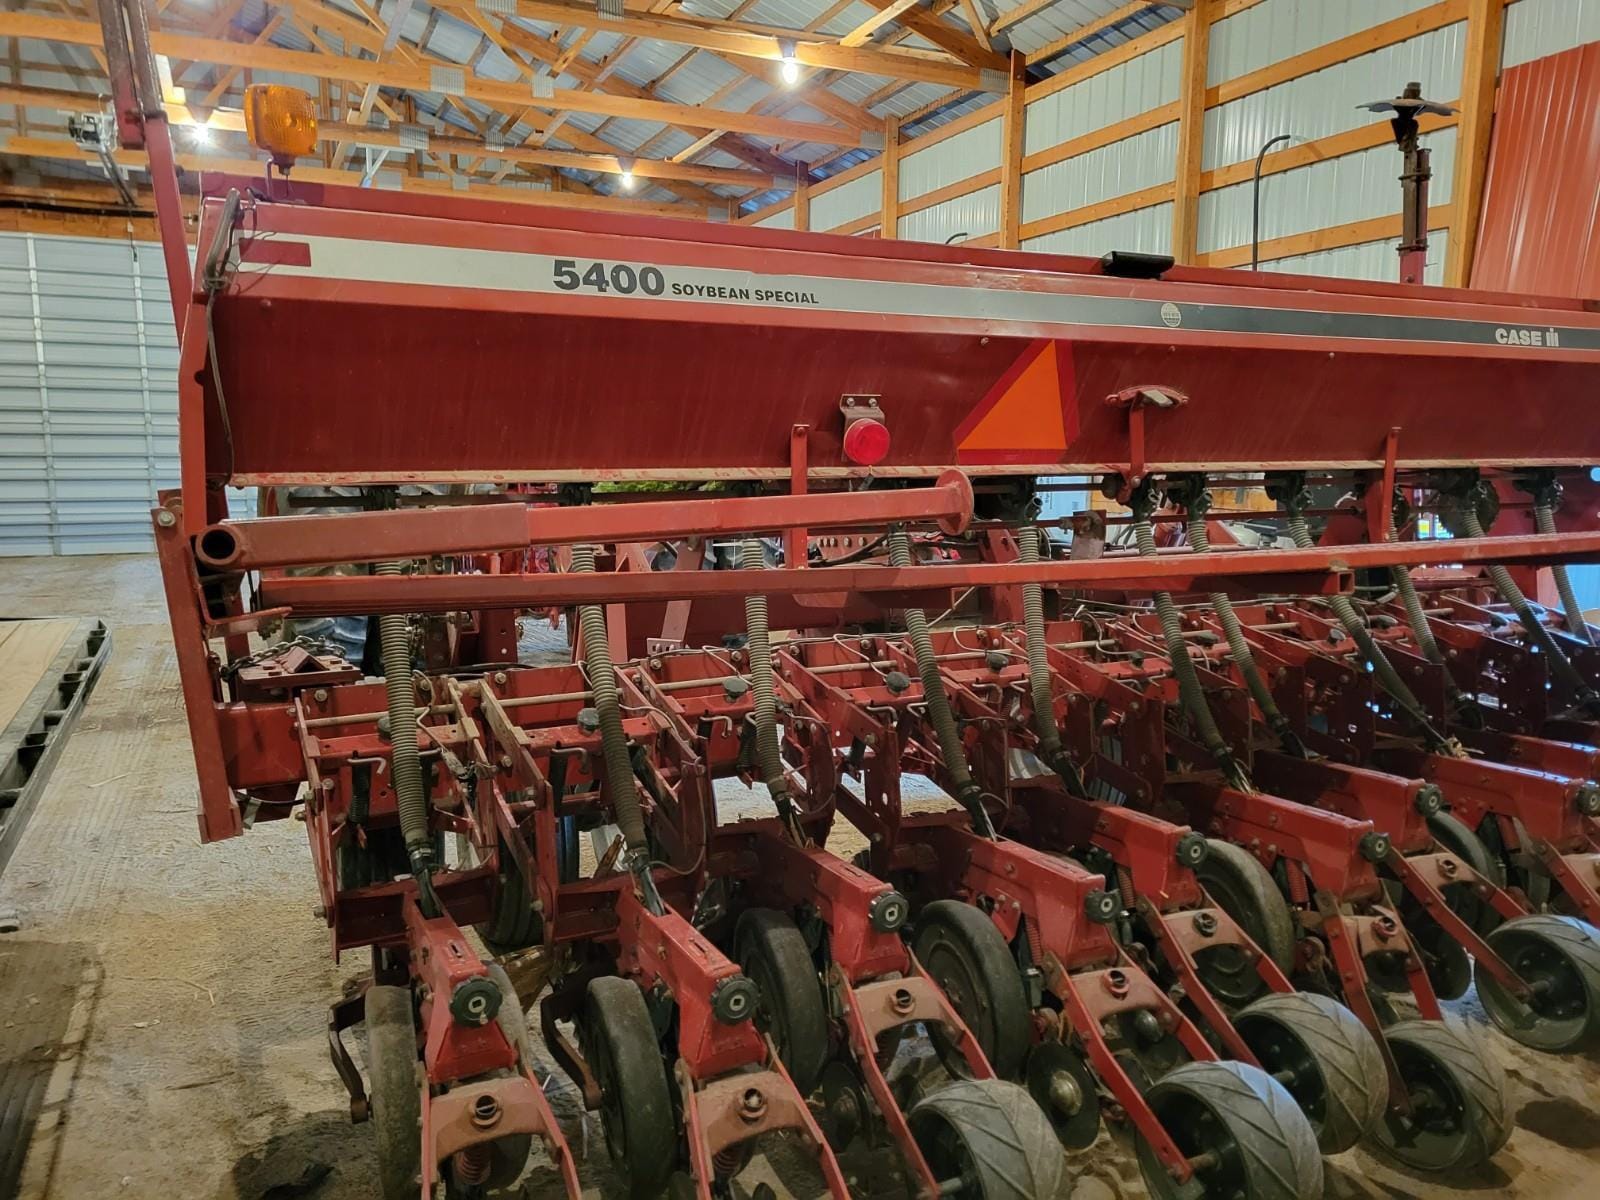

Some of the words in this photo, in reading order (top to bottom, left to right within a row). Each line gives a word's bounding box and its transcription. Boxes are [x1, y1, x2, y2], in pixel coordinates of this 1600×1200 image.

[553, 259, 665, 296] 5400
[671, 283, 750, 300] SOYBEAN
[754, 289, 820, 304] SPECIAL
[1495, 327, 1543, 346] CASE
